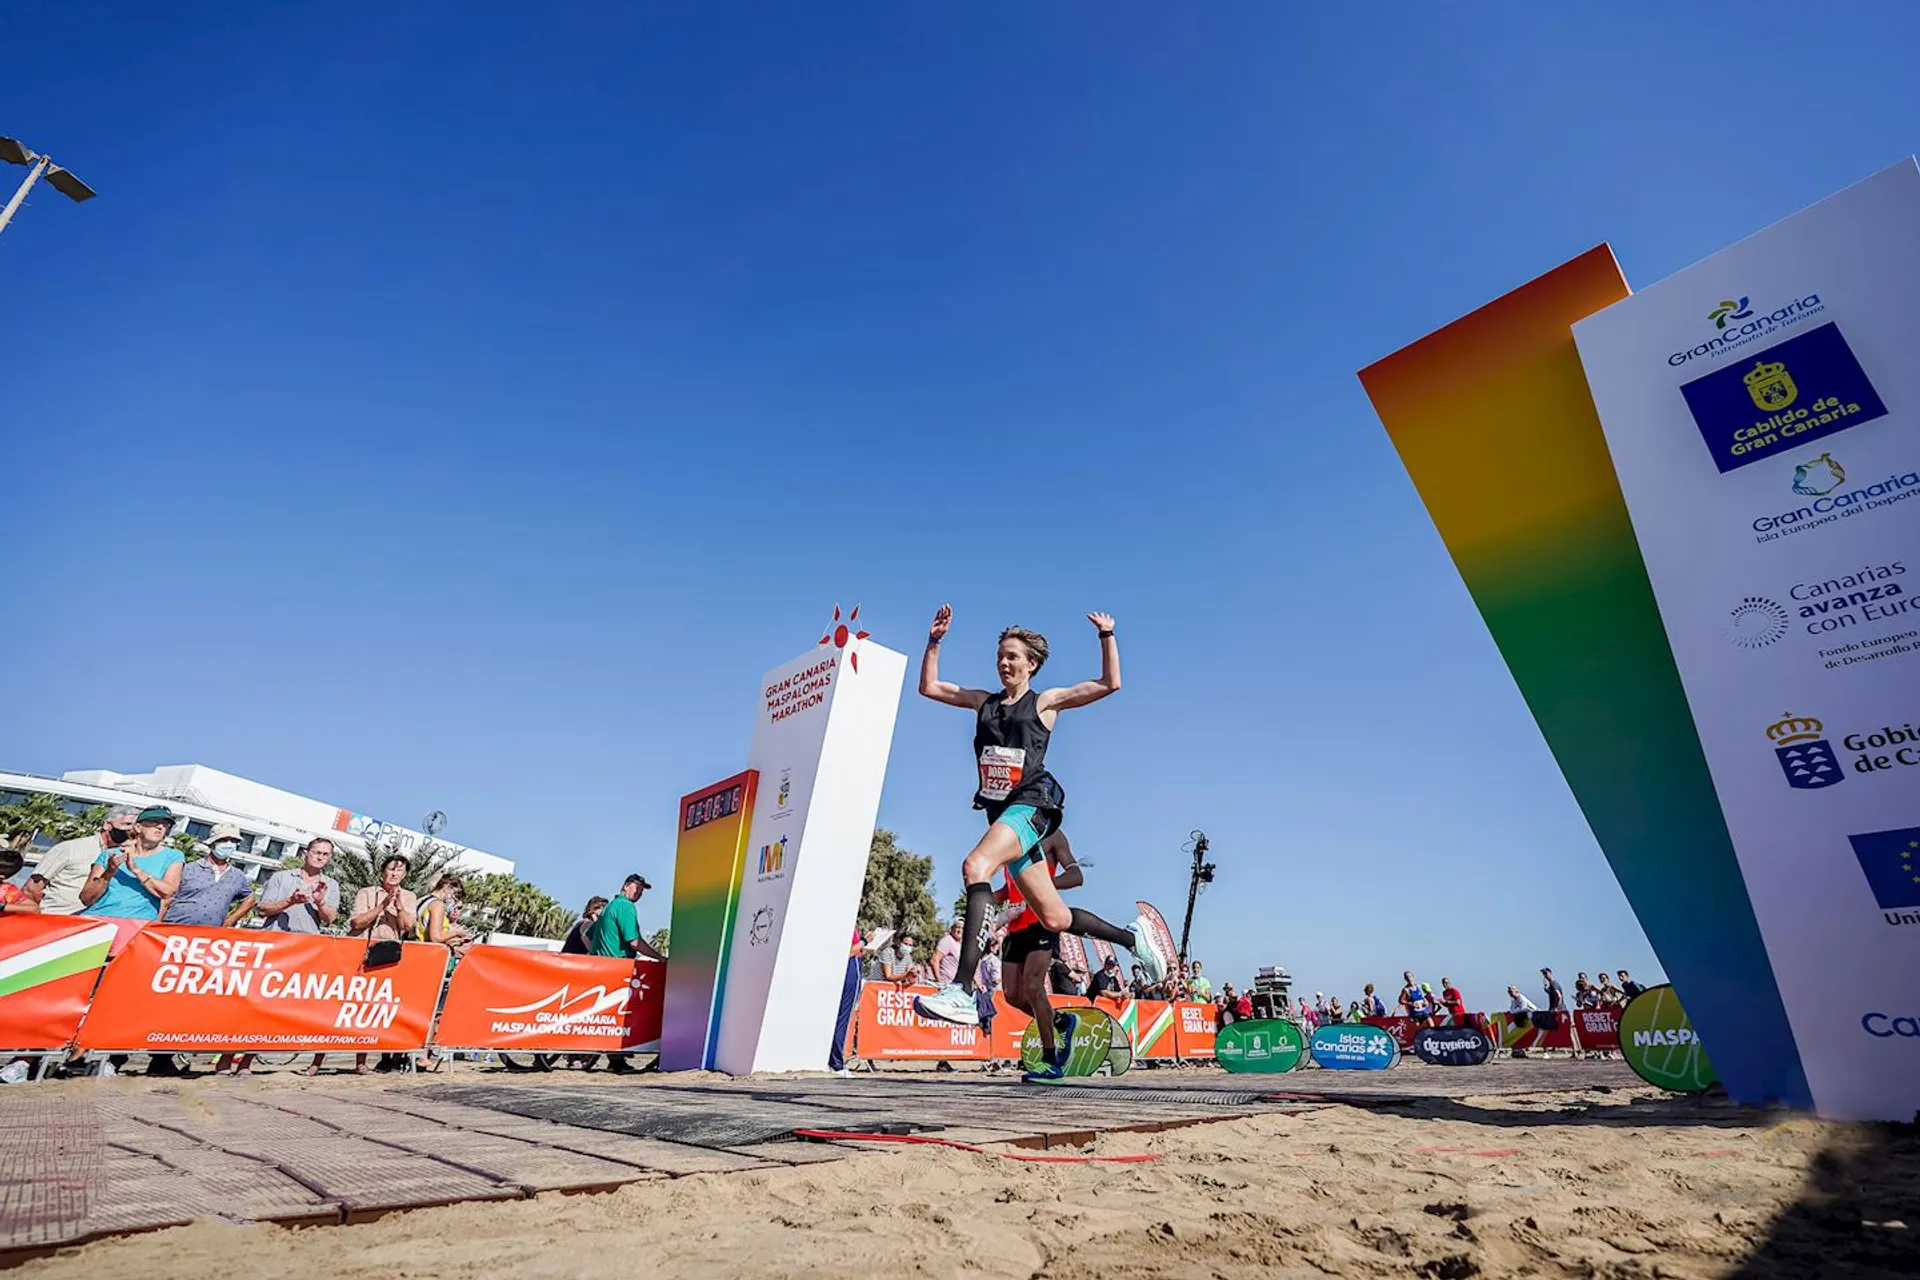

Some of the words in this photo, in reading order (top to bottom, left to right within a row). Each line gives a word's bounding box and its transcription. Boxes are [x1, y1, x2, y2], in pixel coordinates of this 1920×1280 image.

[1710, 332, 1763, 358] Patronato
[1765, 325, 1777, 336] de
[1781, 305, 1825, 328] Turismo
[1730, 433, 1779, 456] Gran
[1780, 403, 1861, 437] Canaria
[1733, 408, 1809, 441] Cabildo
[1812, 397, 1839, 412] de
[1756, 531, 1780, 544] Isla
[1781, 514, 1838, 536] Europea
[1841, 504, 1864, 518] del
[1790, 561, 1906, 601] Canarias
[1798, 583, 1903, 618] avanza
[1807, 613, 1857, 635] con
[1818, 643, 1859, 658] Fondo
[1861, 630, 1918, 649] Europeo
[1825, 660, 1841, 670] de
[1843, 645, 1911, 666] Desarrollo
[766, 678, 791, 698] GRAN
[793, 657, 836, 685] CANARIA
[767, 673, 831, 711] MASPALOMAS
[771, 691, 824, 724] MARATHON
[1843, 723, 1920, 751] Gobi
[1854, 754, 1893, 773] de
[379, 823, 415, 849] Palm
[160, 935, 274, 970] RESET.
[151, 964, 253, 997] GRAN
[259, 970, 401, 1004] CANARIA.
[334, 1002, 400, 1029] RUN
[491, 1021, 572, 1035] MASPALOMAS
[572, 1025, 631, 1037] MARATHON
[535, 1012, 568, 1023] GRAN
[568, 1014, 617, 1026] CANARIA
[877, 1008, 915, 1027] GRAN
[1582, 1012, 1614, 1023] RESET.
[1585, 1021, 1612, 1033] GRAN
[950, 1029, 976, 1045] RUN
[1315, 1040, 1367, 1054] Canarias
[1339, 1033, 1367, 1044] Islas
[1423, 1037, 1440, 1056] dg
[1440, 1040, 1477, 1050] EVENTOS
